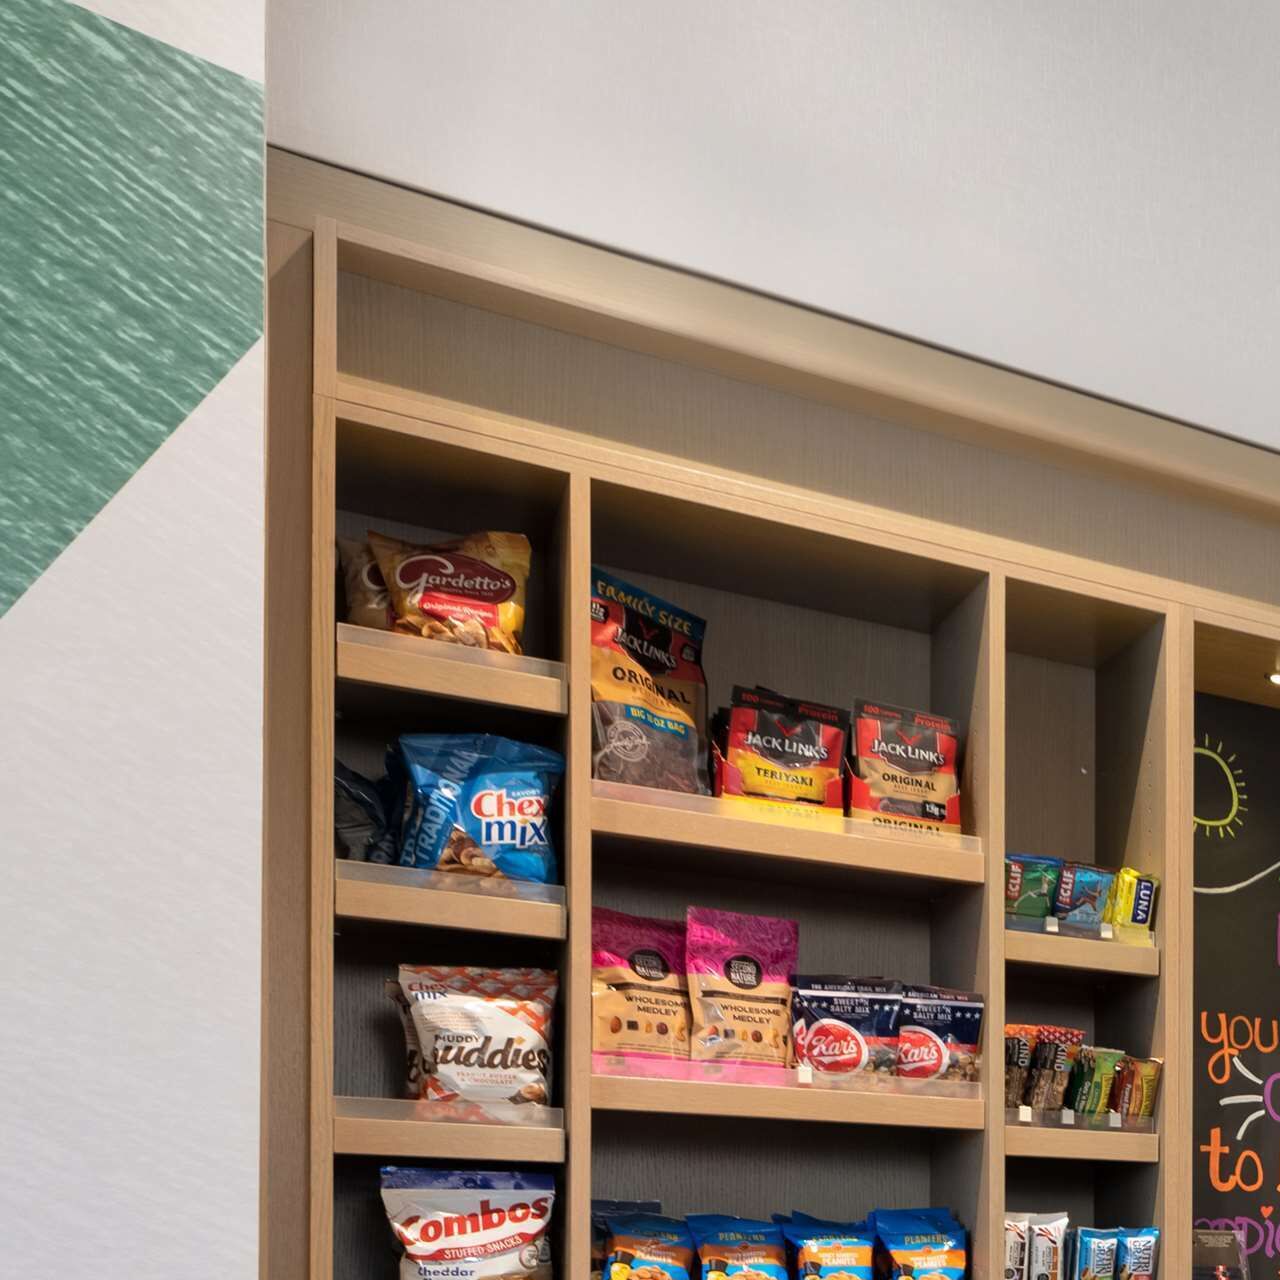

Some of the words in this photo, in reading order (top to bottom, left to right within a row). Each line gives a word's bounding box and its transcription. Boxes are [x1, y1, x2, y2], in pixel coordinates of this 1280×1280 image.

[395, 554, 513, 606] Gardetto's
[597, 582, 656, 617] FAMILY
[658, 610, 692, 634] SIZE
[612, 666, 691, 704] ORIGINAL
[745, 732, 783, 751] JACK
[872, 739, 907, 759] JACK
[908, 748, 945, 766] LINK'S
[755, 766, 814, 787] TERIYAKI
[881, 772, 937, 792] ORIGINAL
[471, 789, 549, 819] Chex
[481, 817, 549, 848] mix
[1136, 881, 1153, 922] LUNA
[636, 1004, 679, 1017] MEDLEY
[720, 1003, 782, 1017] WHOLESOME
[732, 1013, 772, 1025] MEDLEY
[811, 1035, 858, 1057] Kar's
[1017, 1037, 1031, 1067] KIND
[1054, 1043, 1069, 1072] KIND
[1200, 1011, 1279, 1085] you
[1199, 1127, 1264, 1193] to
[396, 1195, 549, 1246] Combos
[485, 1235, 522, 1255] SNACKS
[417, 1266, 476, 1279] Cheddar
